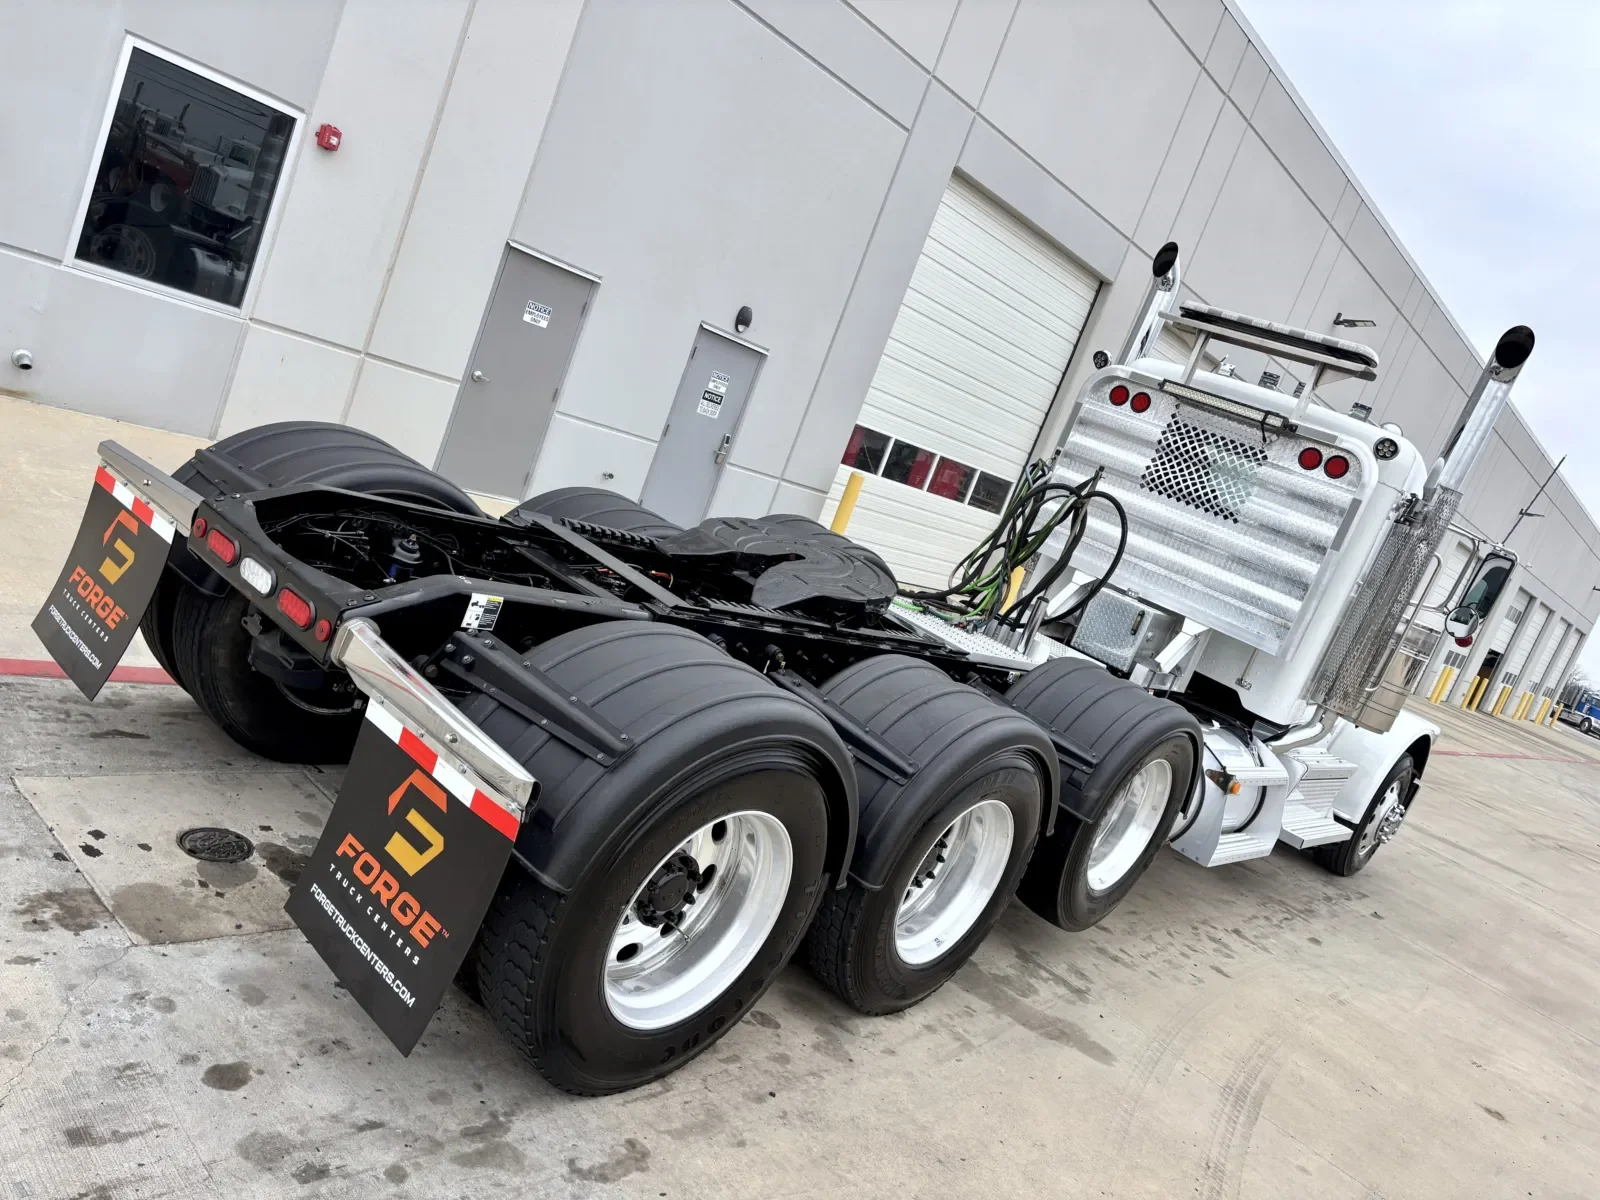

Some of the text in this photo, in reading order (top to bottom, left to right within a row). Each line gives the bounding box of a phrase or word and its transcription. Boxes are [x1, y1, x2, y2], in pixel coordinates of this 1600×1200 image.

[528, 301, 551, 316] NOTICE
[703, 391, 722, 404] NOTICE
[62, 588, 109, 642] TRUCK CENTERS
[68, 565, 125, 630] FORGE
[48, 604, 102, 670] FORGETRUCKCENTERS.COM
[329, 863, 420, 965] TRUCK CENTERS
[335, 832, 442, 948] FORGE
[310, 882, 416, 1008] FORGETRUCKCENTERS.COM
